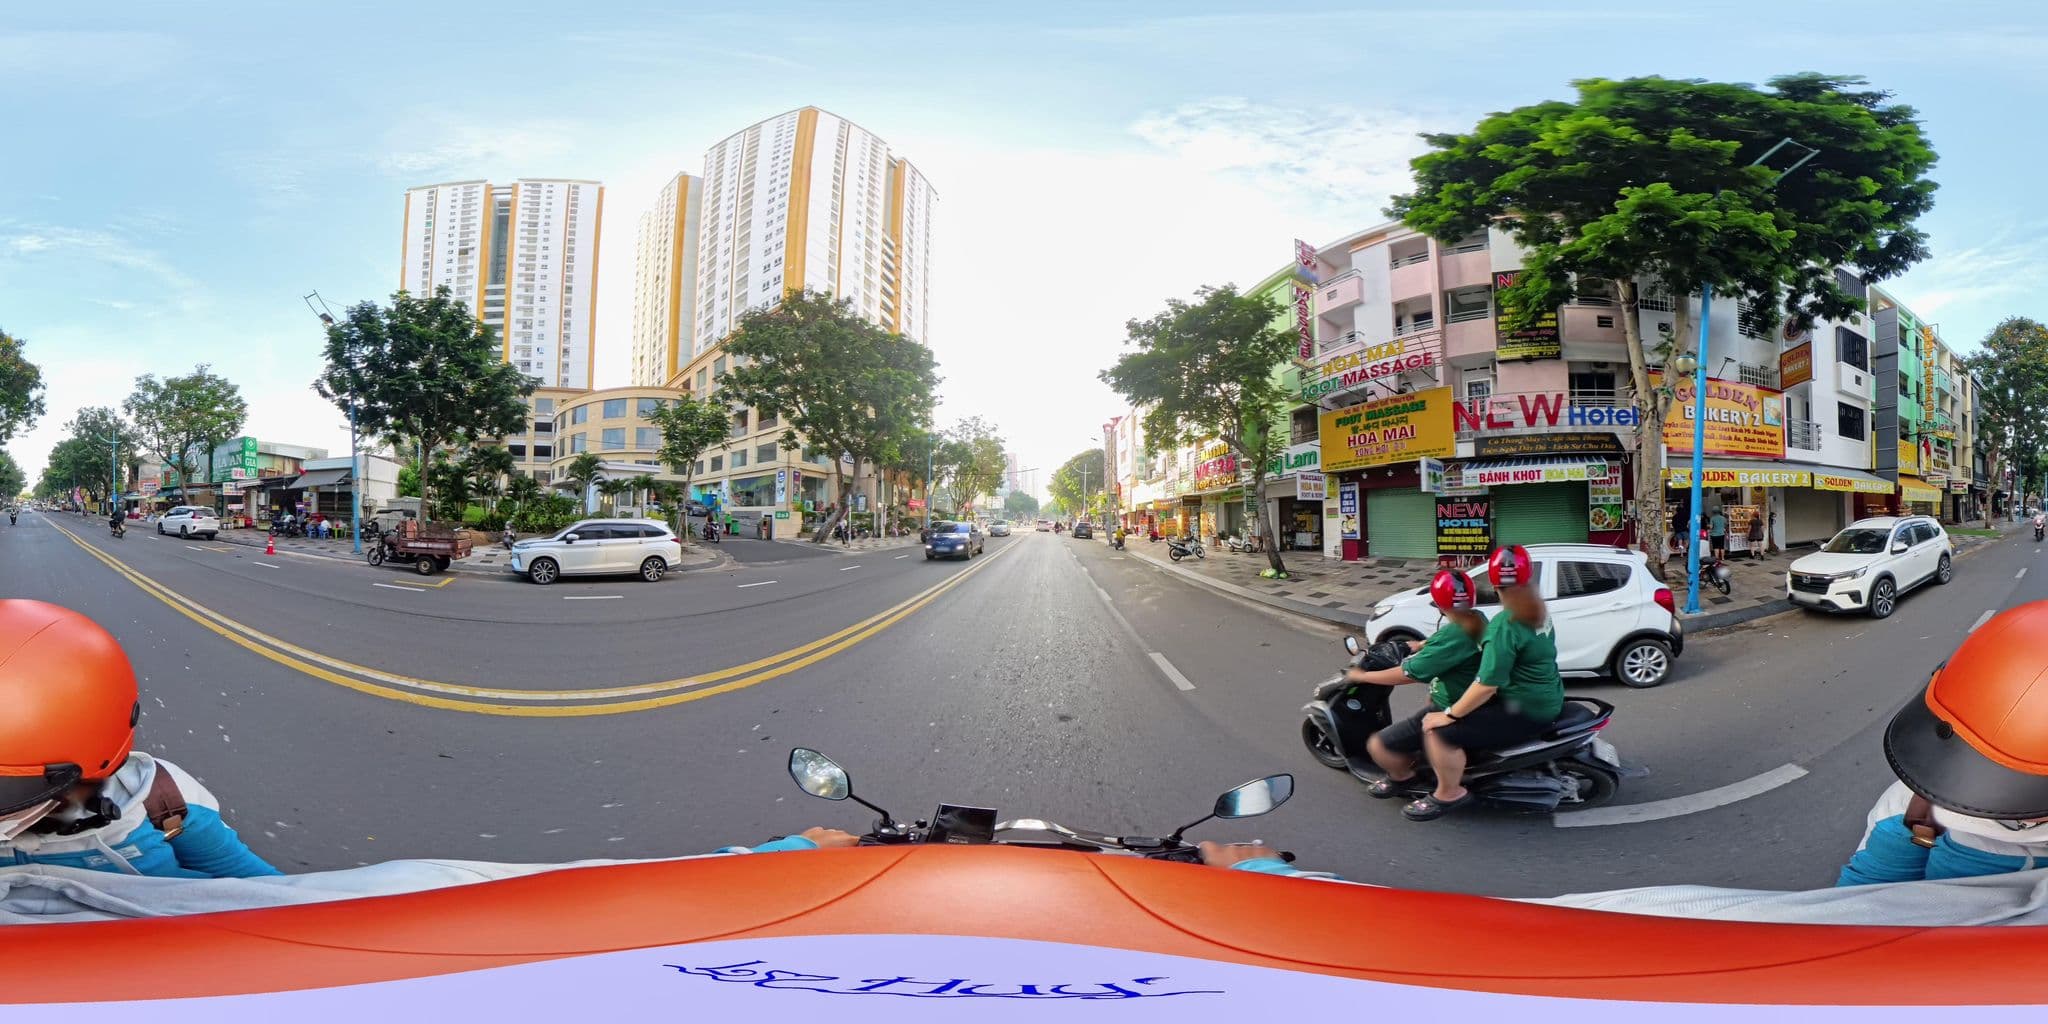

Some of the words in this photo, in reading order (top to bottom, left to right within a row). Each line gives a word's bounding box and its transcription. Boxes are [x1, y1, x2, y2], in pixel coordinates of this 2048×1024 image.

[1296, 286, 1312, 359] MASSAGE
[1322, 354, 1361, 377] HOA
[1366, 339, 1406, 362] MAI
[1782, 350, 1809, 366] GOLDEN
[1301, 376, 1339, 401] FOOT
[1342, 352, 1433, 387] MASSAGE
[1335, 412, 1362, 428] FOOT
[1365, 400, 1427, 422] MASSAGE
[1453, 393, 1564, 433] NEW
[1568, 405, 1639, 426] Hotel
[1684, 405, 1749, 426] BKERY
[1752, 414, 1760, 426] 2
[1347, 430, 1378, 447] HOA
[1383, 425, 1415, 441] MAI
[1285, 450, 1318, 470] Lam
[246, 468, 255, 477] AN
[1479, 469, 1510, 483] BÁNH
[1513, 469, 1542, 483] KHỌT
[1739, 472, 1798, 484] BAKERY
[1801, 474, 1809, 484] 2
[1824, 477, 1852, 487] GOLDEN
[1437, 502, 1488, 518] NEW
[1438, 518, 1488, 527] HOTEL
